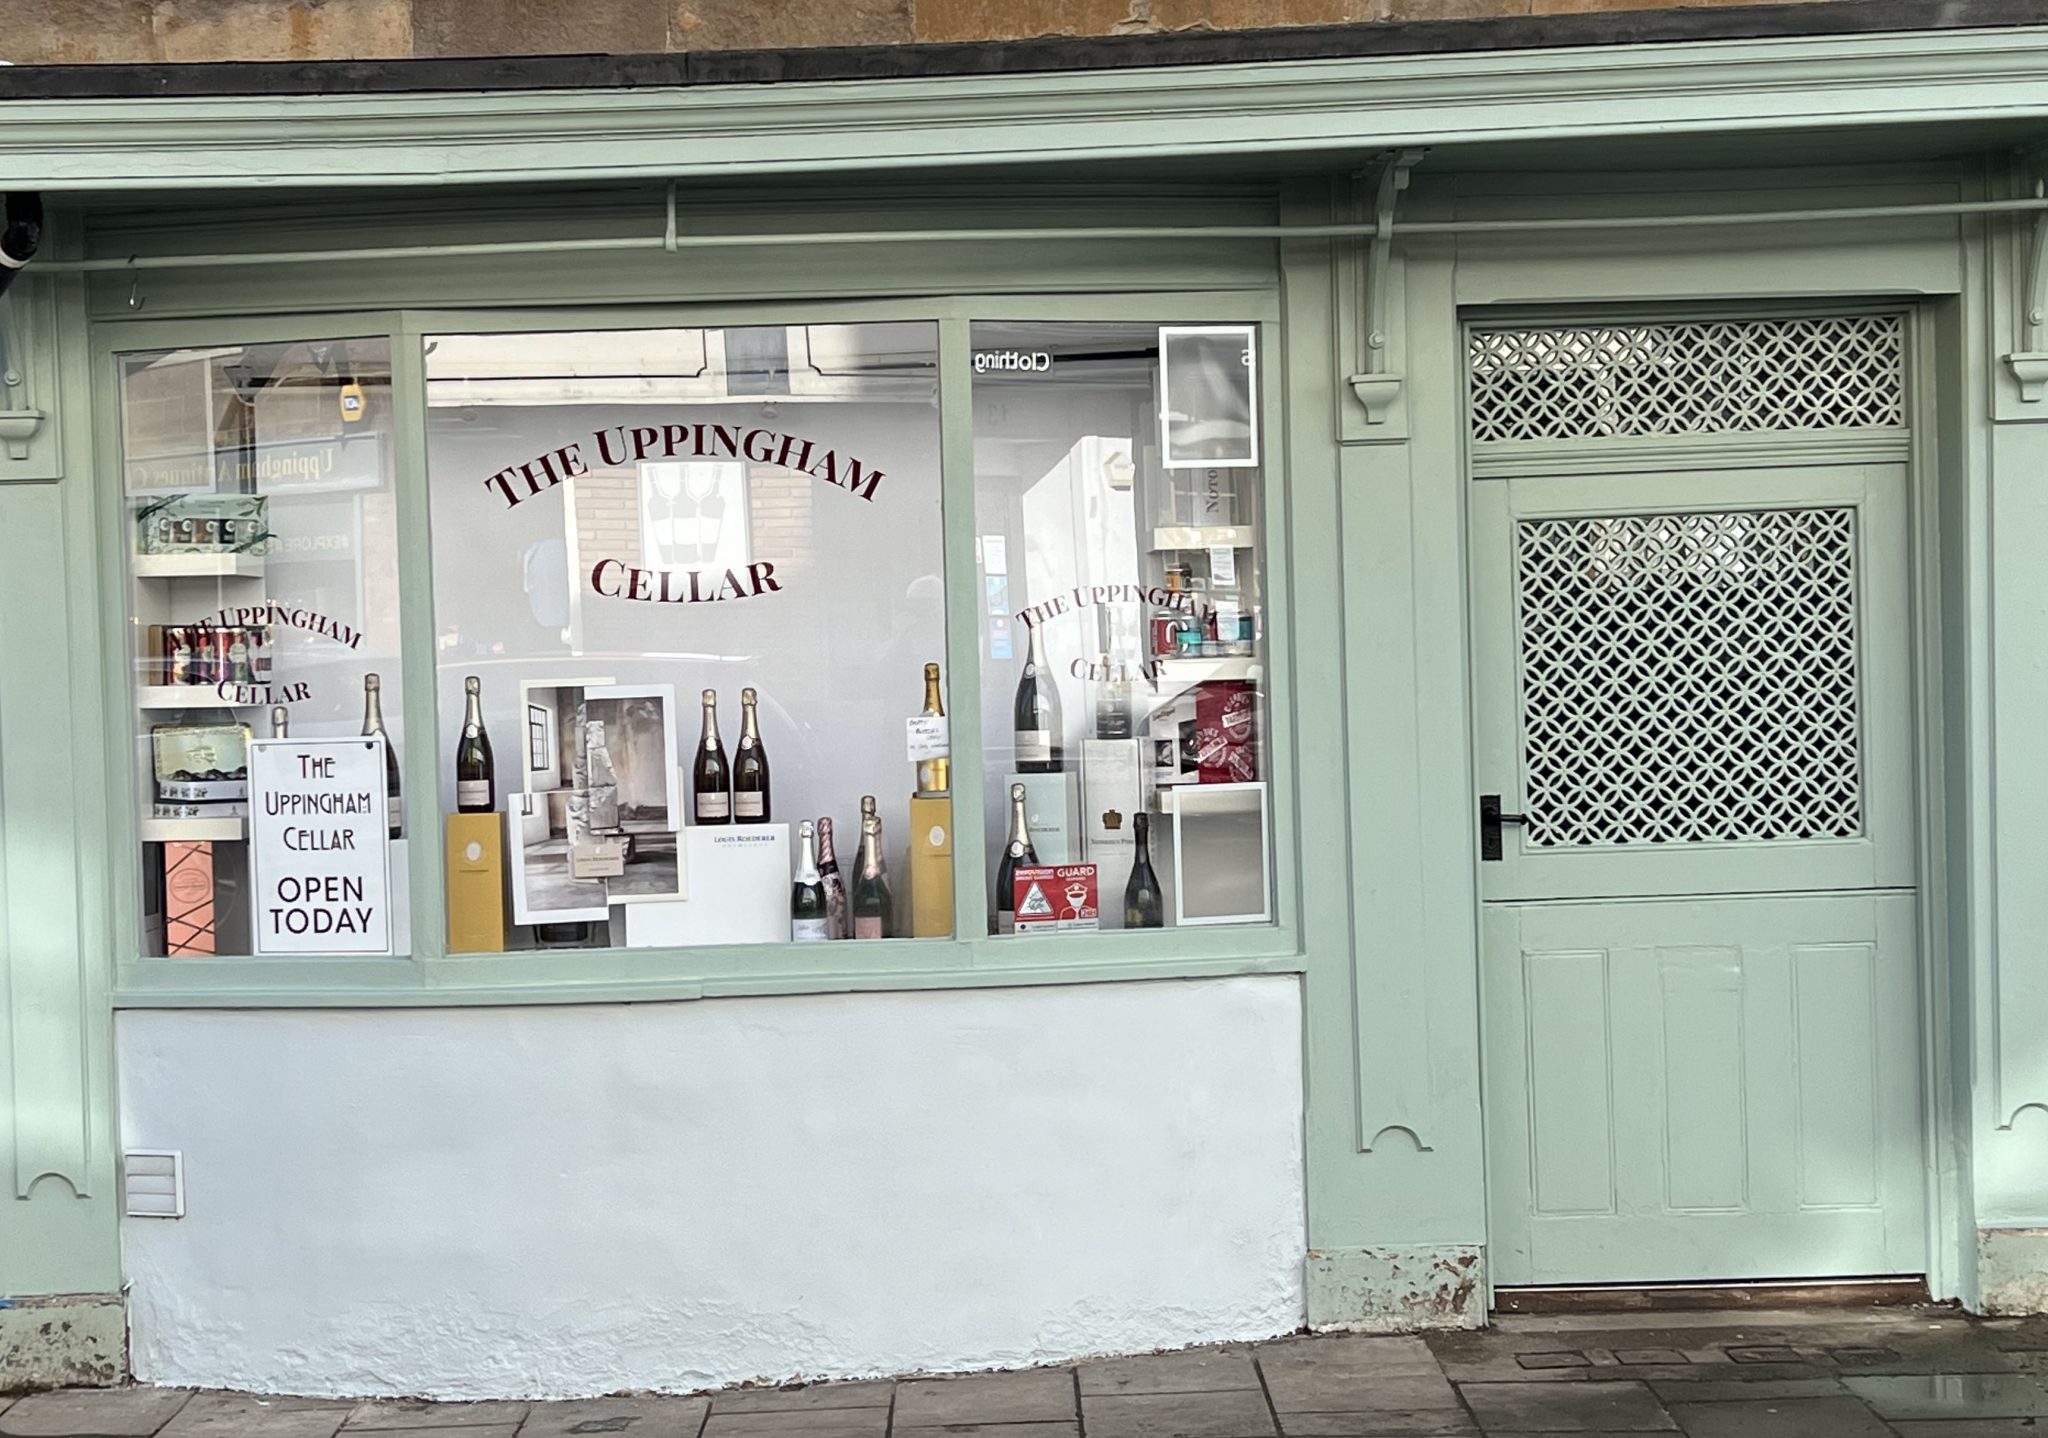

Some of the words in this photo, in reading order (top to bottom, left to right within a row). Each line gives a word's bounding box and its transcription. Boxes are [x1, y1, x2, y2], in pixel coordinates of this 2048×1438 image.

[484, 441, 588, 510] THE
[592, 423, 887, 504] UPPINGHAM
[590, 558, 784, 604] CELLAR
[1016, 595, 1070, 630] THE
[218, 606, 364, 651] UPPINGHAM
[1070, 657, 1168, 683] CELLAR
[216, 681, 312, 705] CELLAR
[297, 754, 336, 779] THE
[265, 791, 371, 816] UPPINGHAM
[283, 826, 356, 851] CELLAR
[1057, 866, 1095, 878] GUARD
[277, 876, 363, 902] OPEN
[269, 907, 374, 934] TODAY
